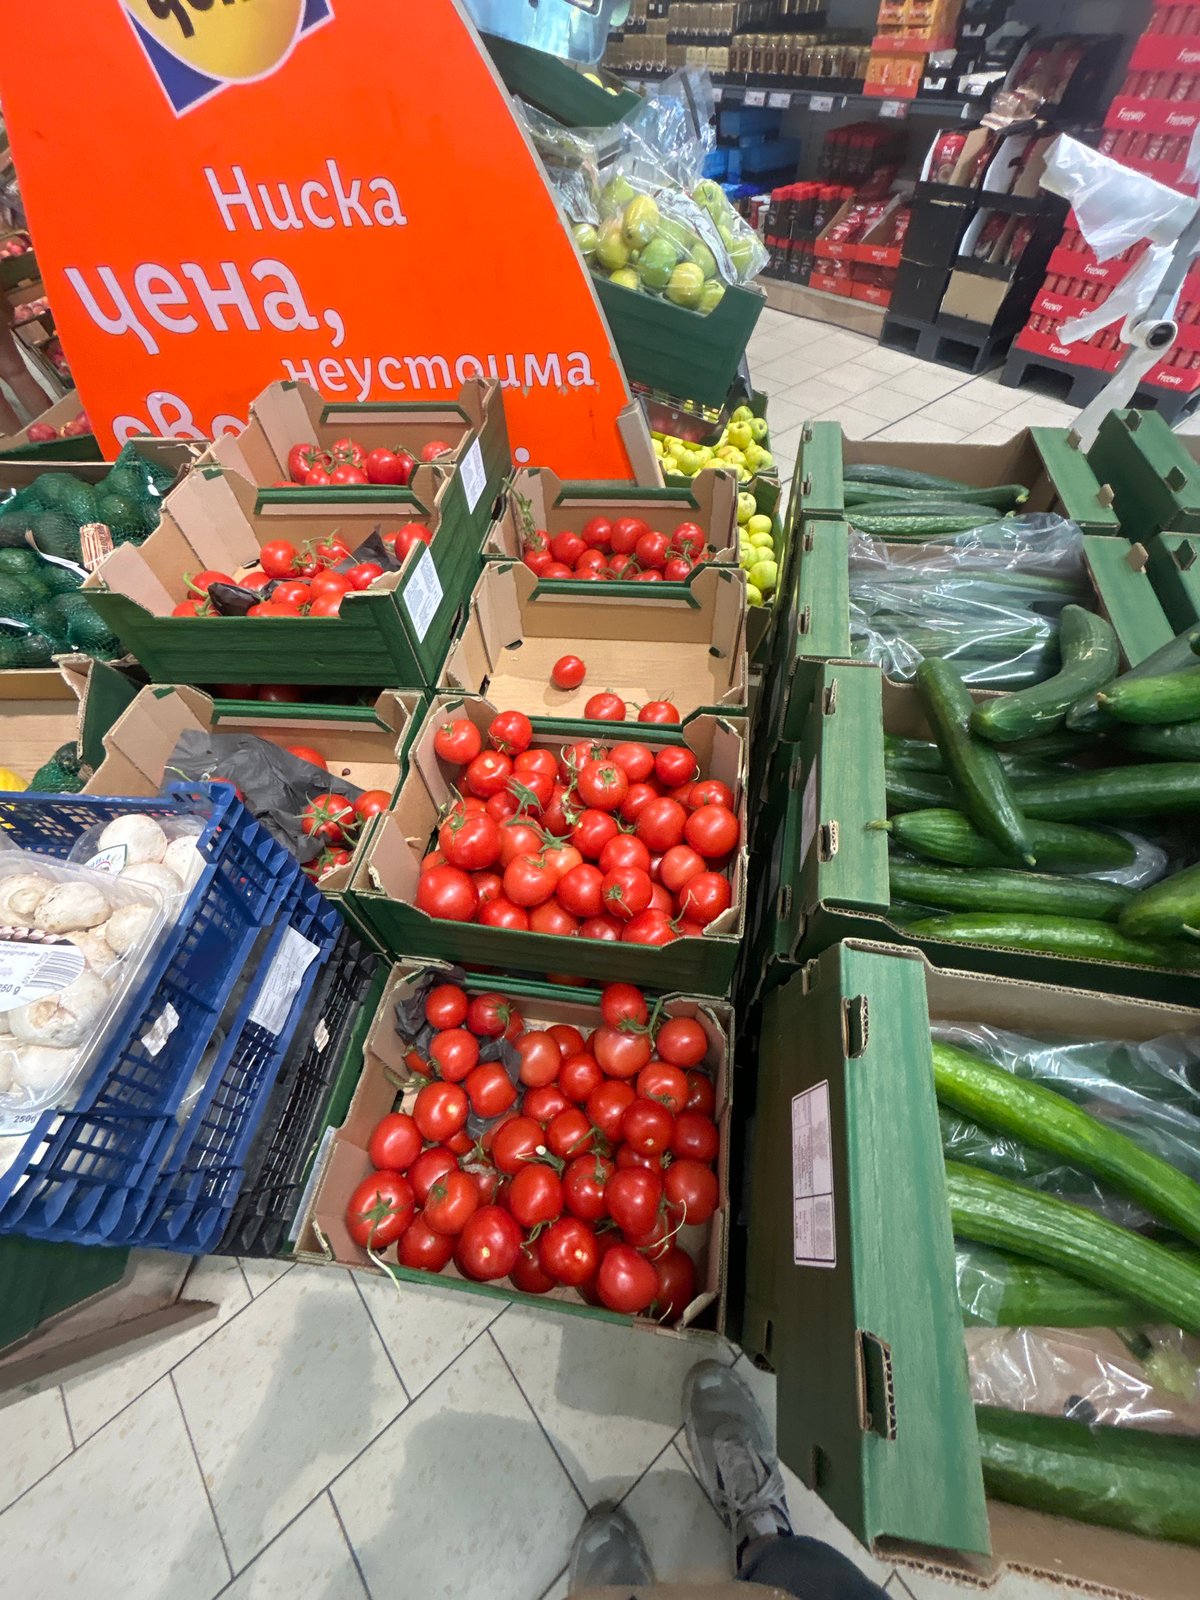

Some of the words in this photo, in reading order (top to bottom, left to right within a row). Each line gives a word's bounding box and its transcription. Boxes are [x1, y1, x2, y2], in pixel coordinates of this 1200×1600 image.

[203, 158, 408, 232] Ниска
[63, 257, 345, 355] цена,
[281, 350, 595, 403] неустоима
[0, 984, 13, 993] 50
